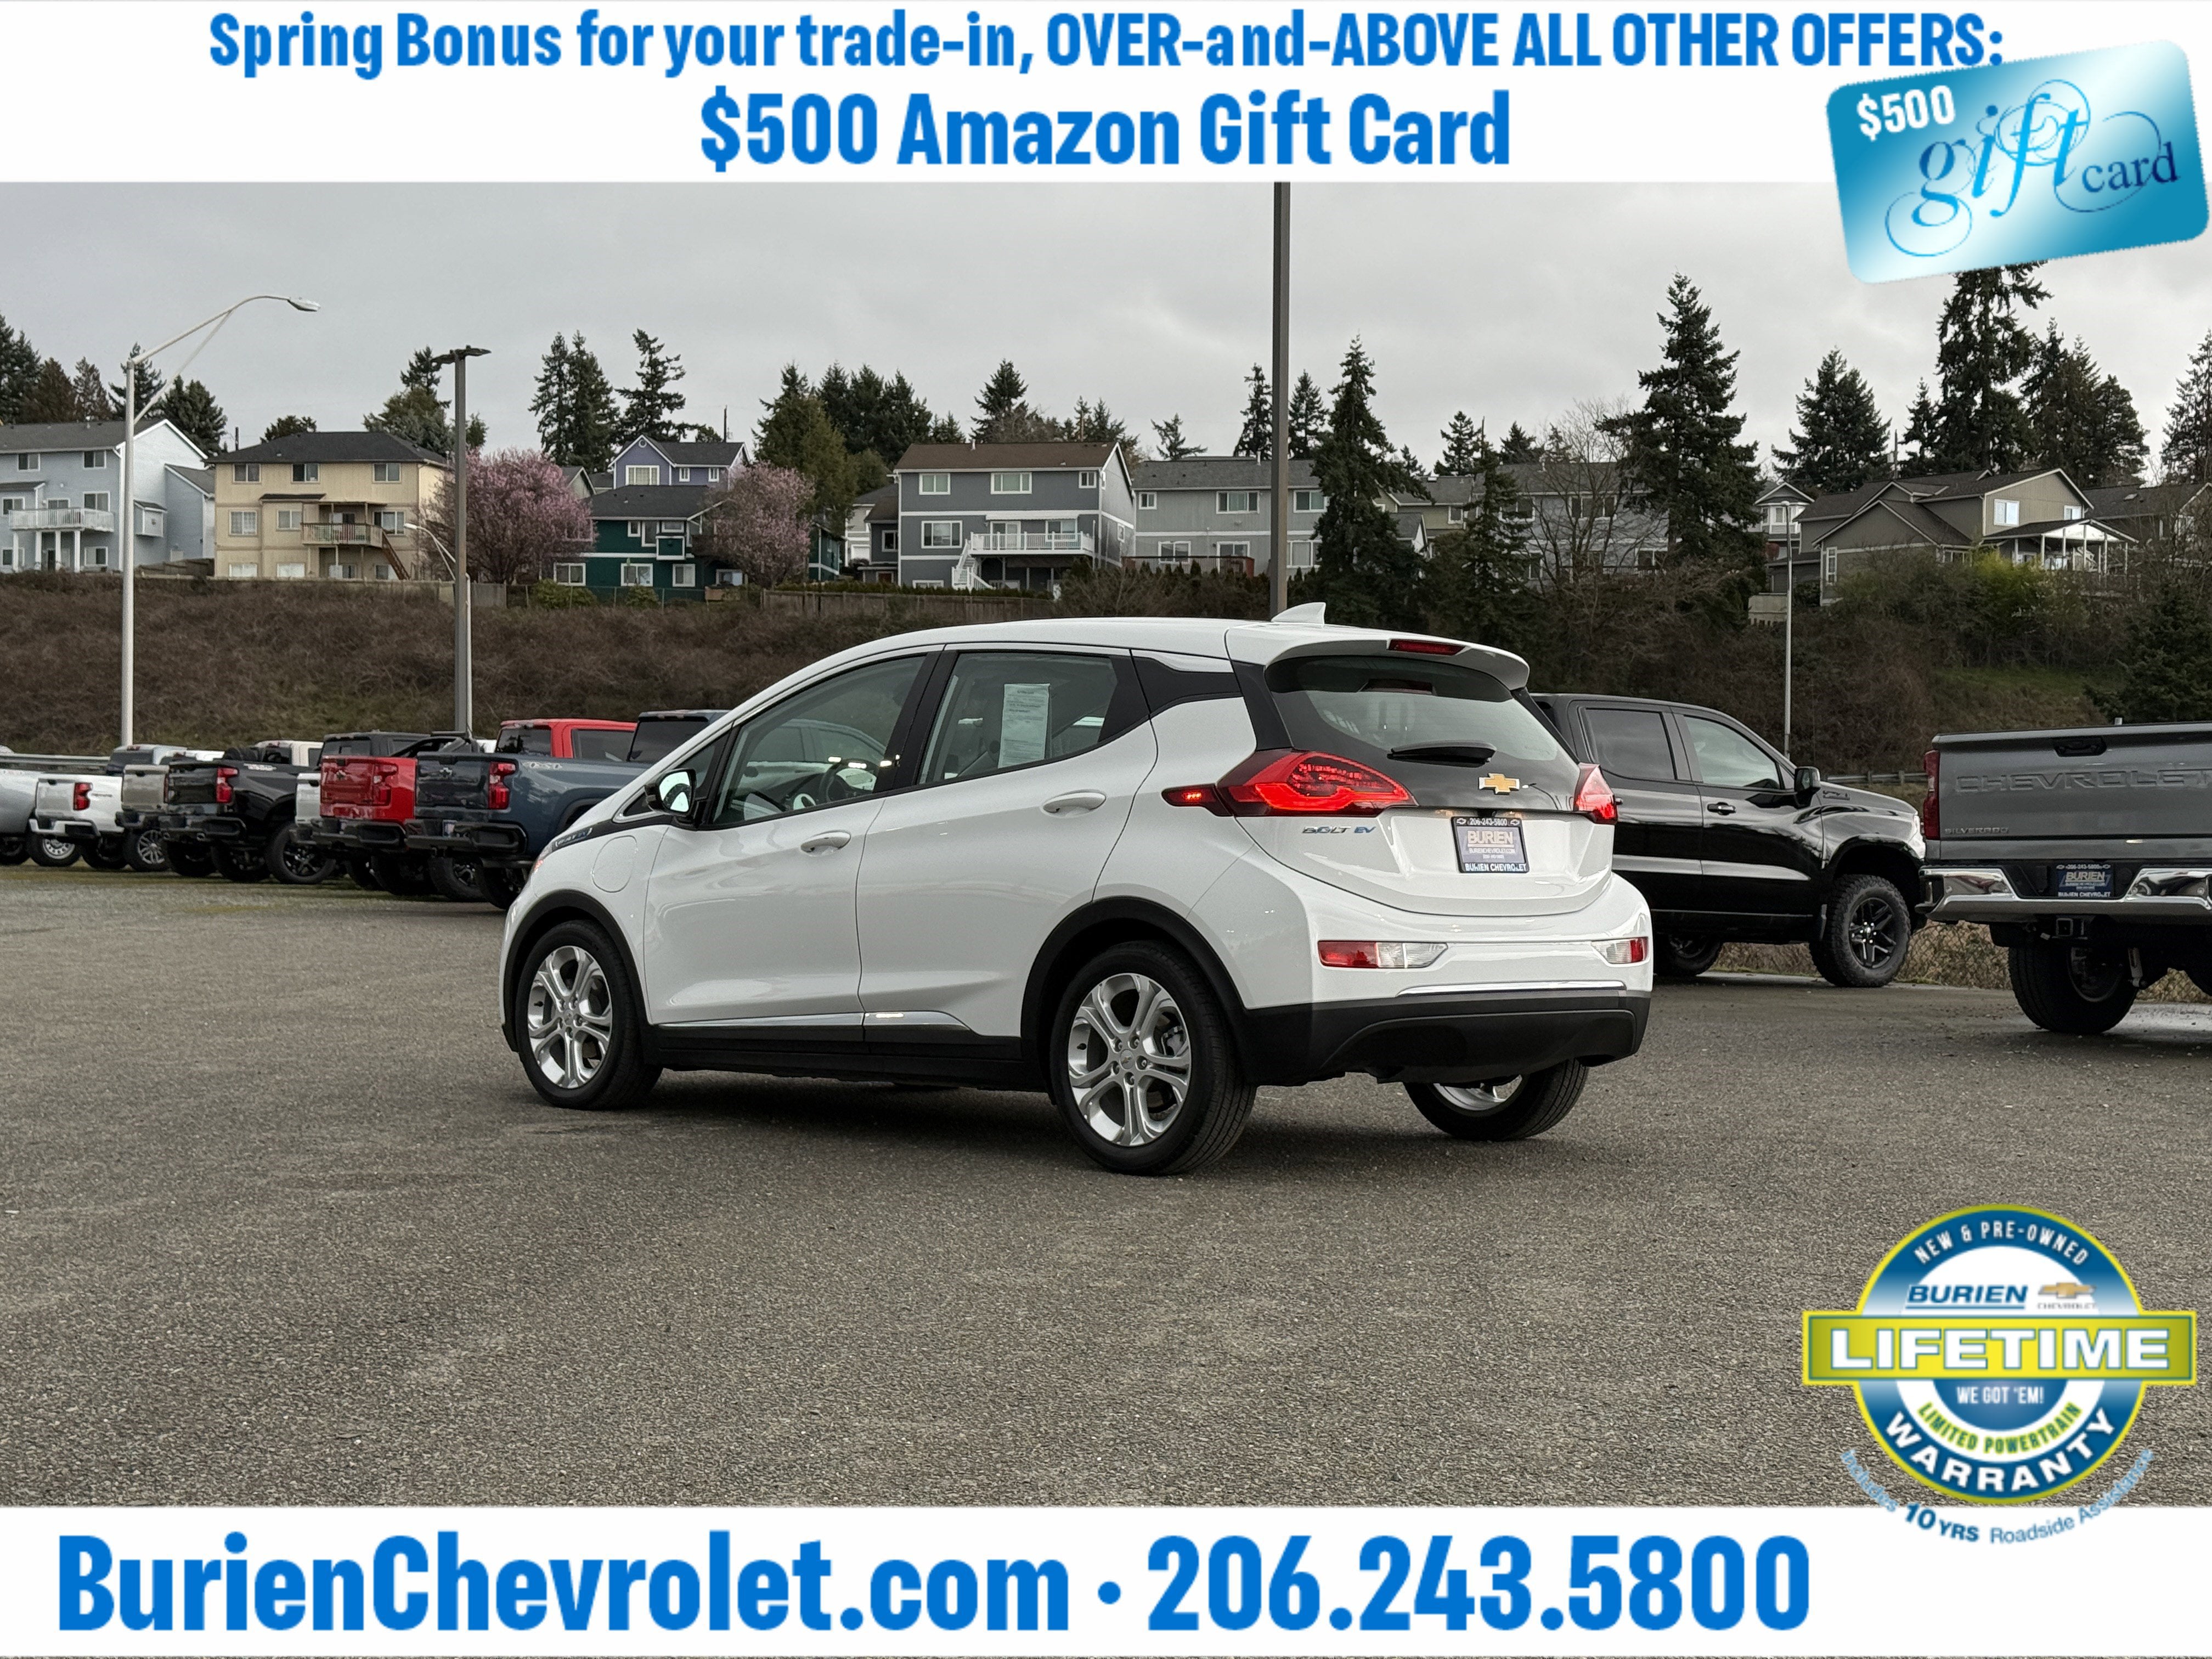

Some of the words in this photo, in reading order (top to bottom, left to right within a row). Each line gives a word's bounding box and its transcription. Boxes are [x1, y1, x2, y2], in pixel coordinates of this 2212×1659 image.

[1469, 818, 1508, 826] 206-243-5800
[1302, 826, 1351, 834] BOLT
[1468, 831, 1513, 844] BURIEN
[1465, 863, 1489, 871] BURIEN
[1490, 863, 1527, 871] CHEVROLET
[2066, 871, 2105, 881] BURIEN
